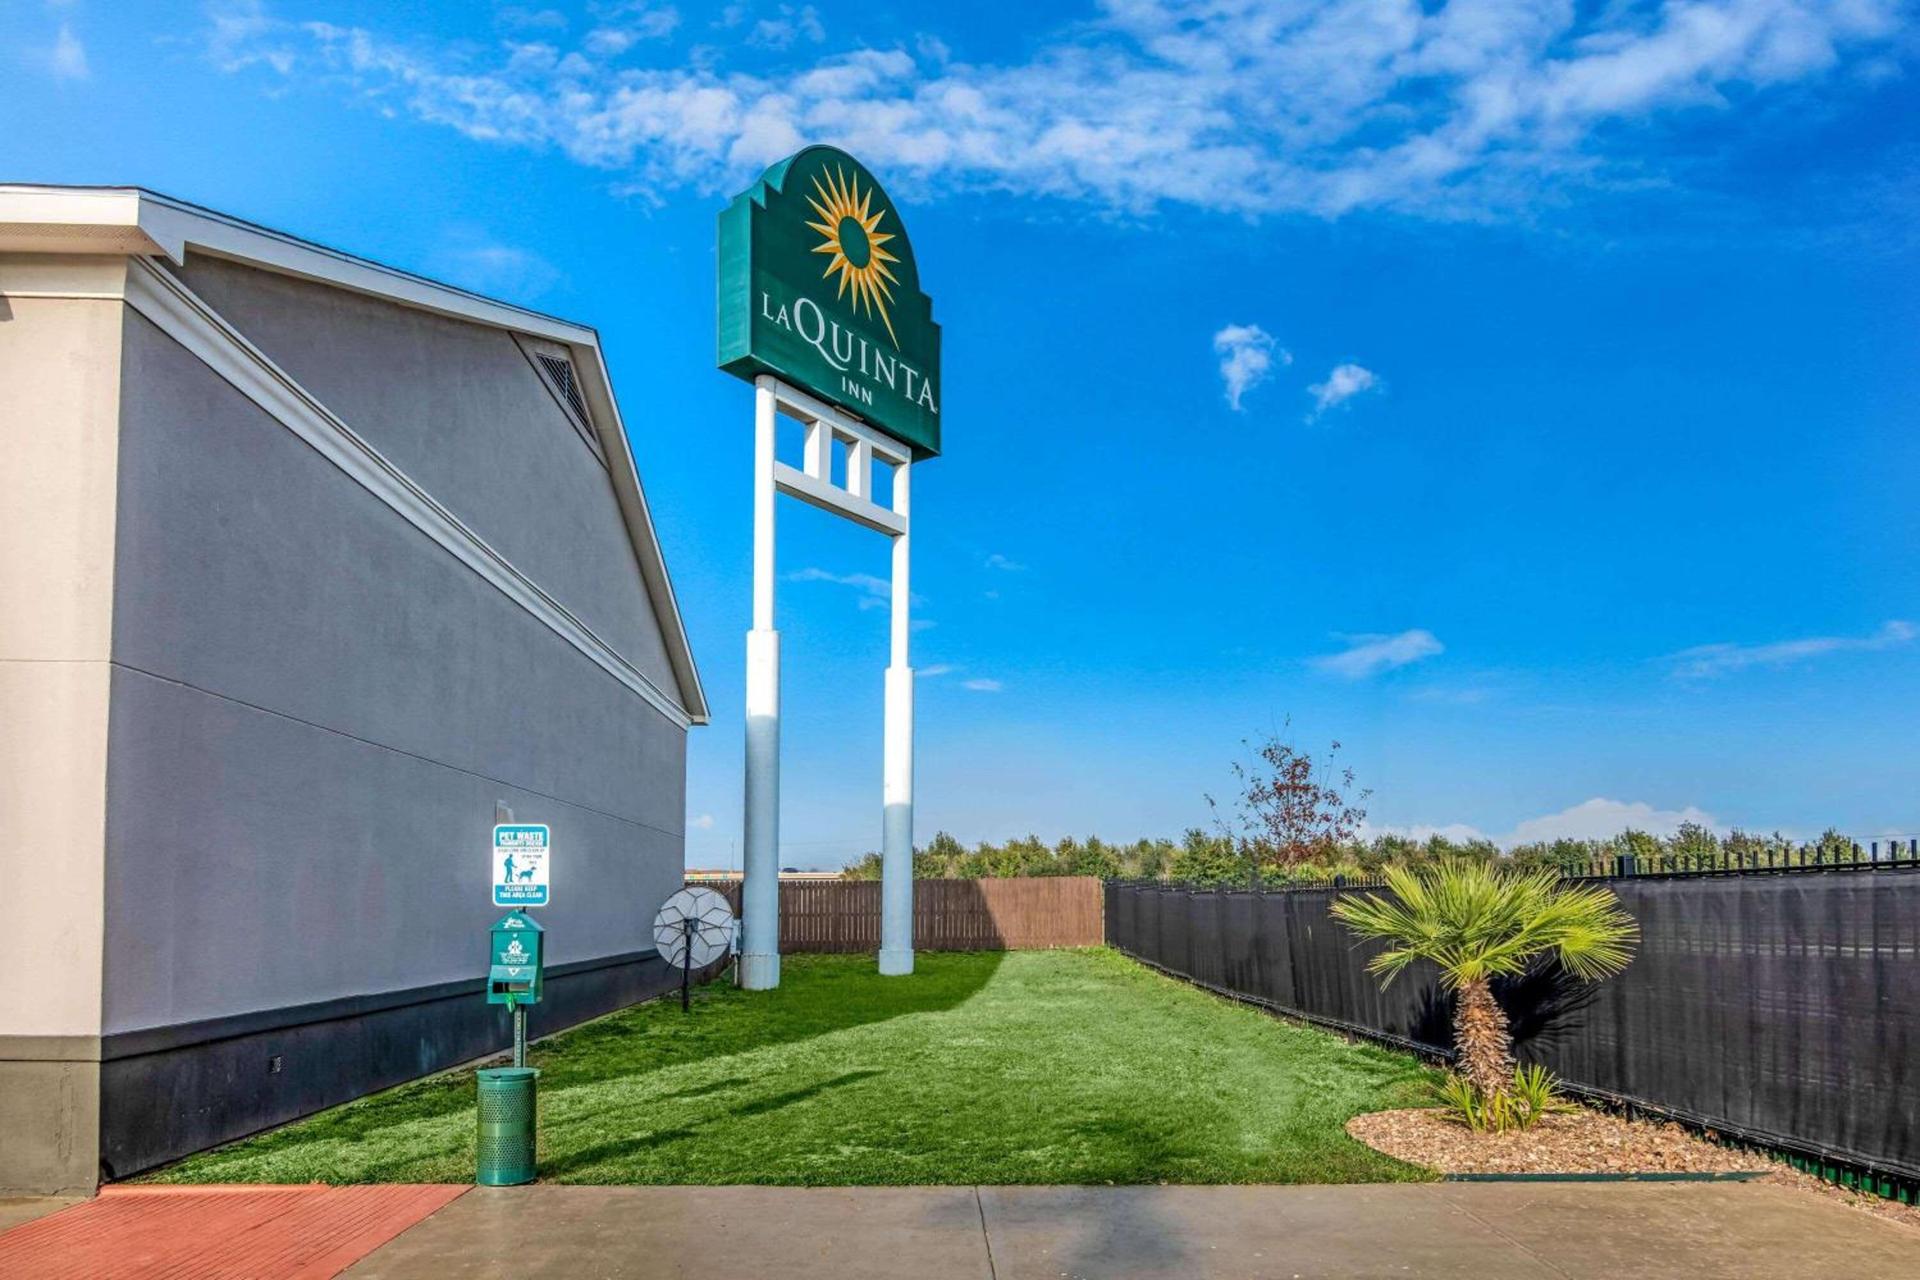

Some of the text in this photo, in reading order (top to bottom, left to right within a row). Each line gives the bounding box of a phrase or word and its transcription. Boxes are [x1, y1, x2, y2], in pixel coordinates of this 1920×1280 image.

[762, 292, 939, 415] LA QUINTA
[841, 376, 873, 406] INN
[499, 831, 544, 841] PET WASTE
